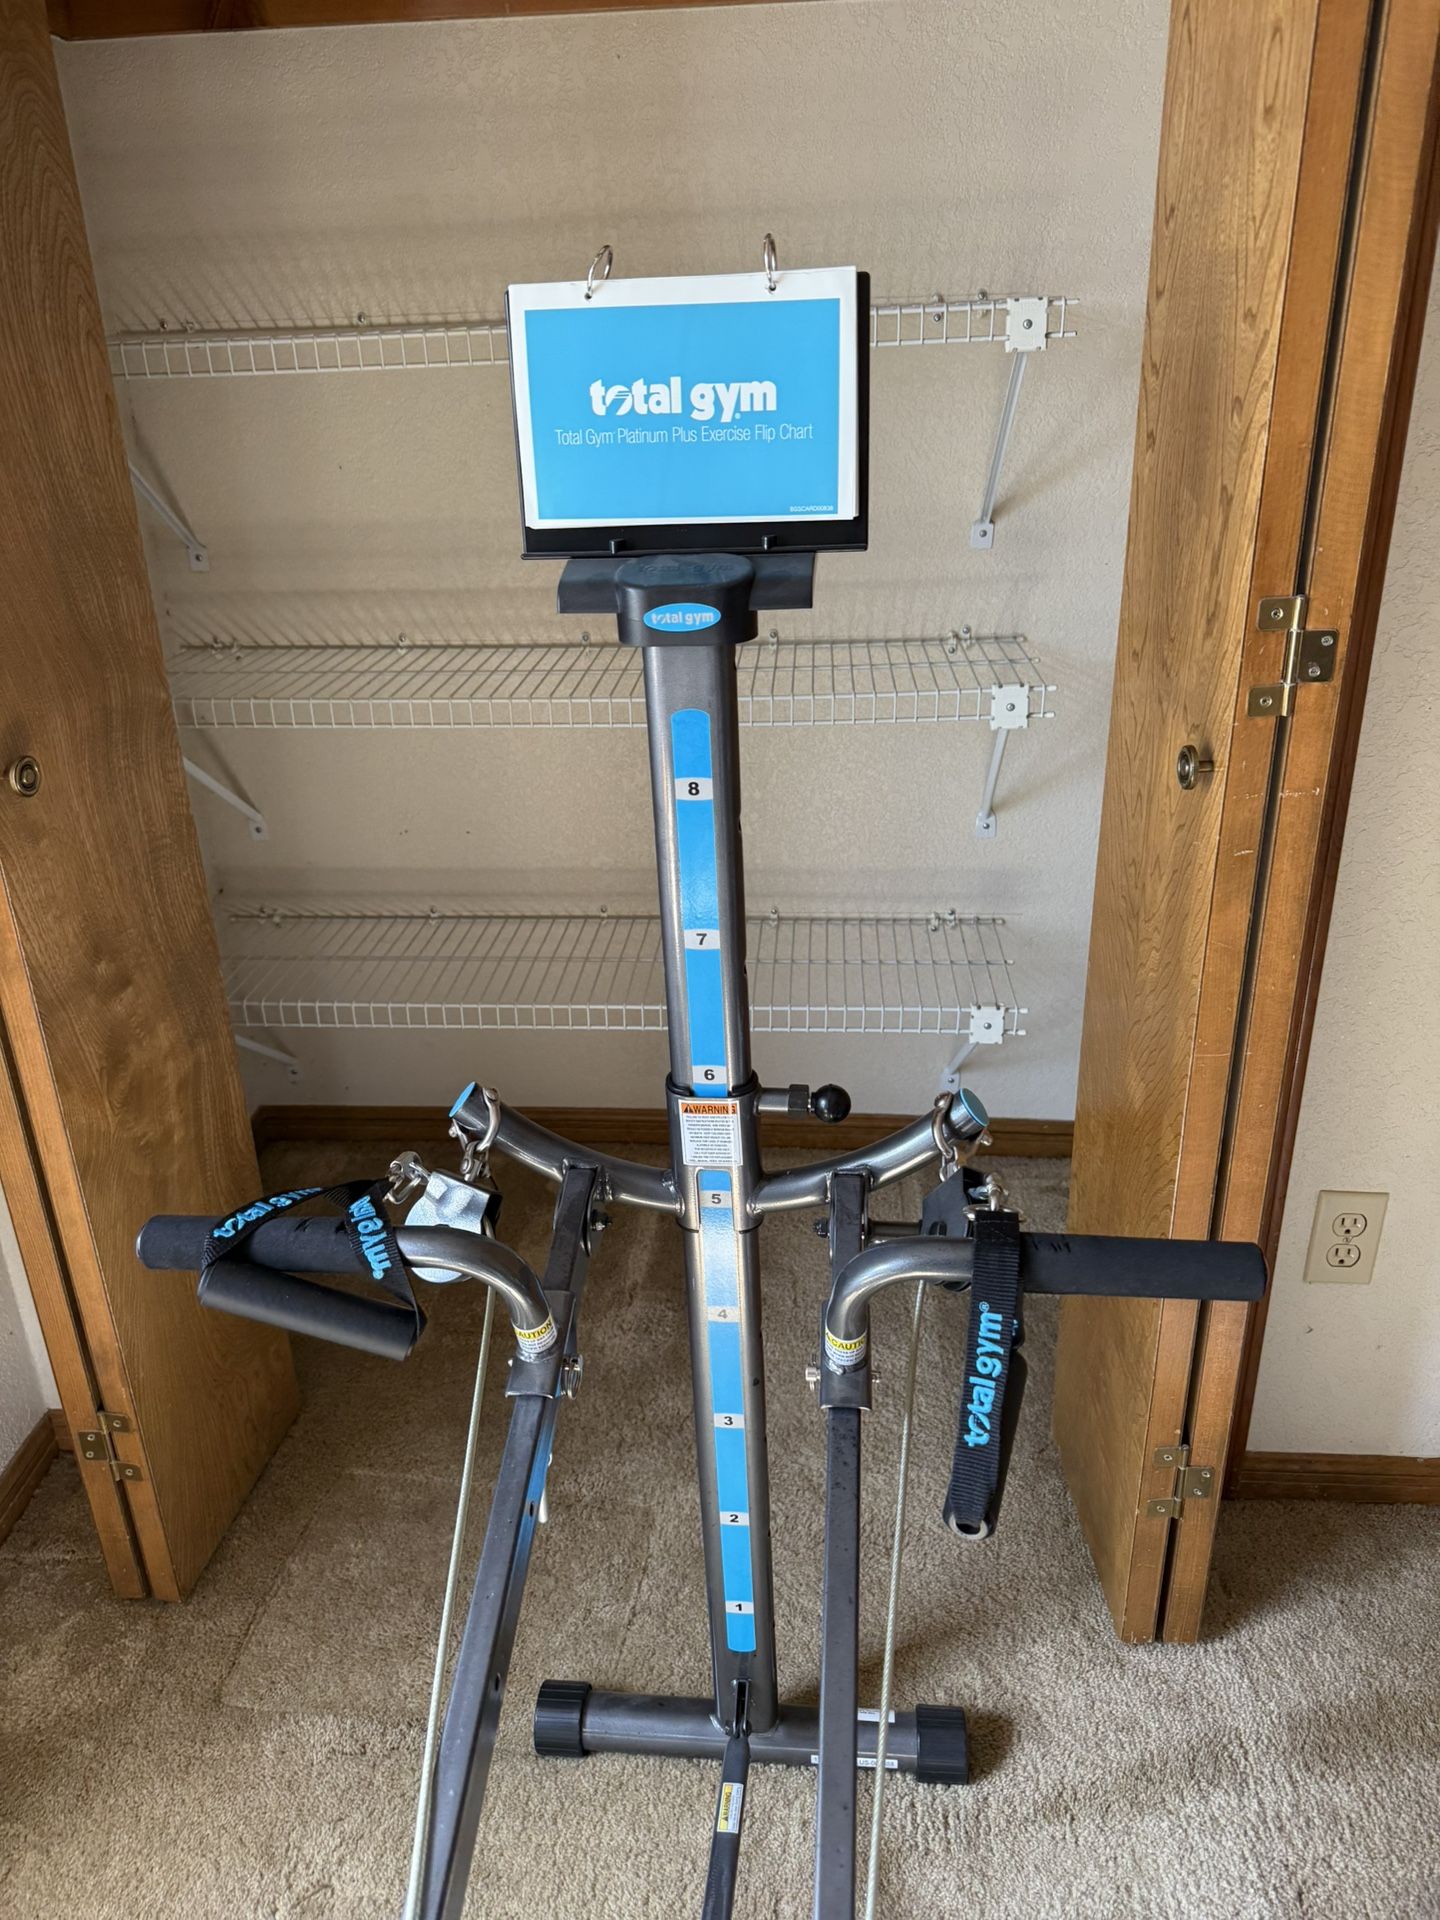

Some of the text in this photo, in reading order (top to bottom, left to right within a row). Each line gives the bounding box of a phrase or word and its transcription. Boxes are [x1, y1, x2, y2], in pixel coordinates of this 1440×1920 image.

[589, 376, 777, 423] total gym
[554, 429, 582, 446] Total
[617, 427, 668, 444] Platinum
[672, 426, 698, 442] Plus
[701, 425, 751, 442] Exercise
[755, 424, 776, 443] Flip
[780, 423, 814, 440] Chart
[651, 611, 714, 625] total gym
[688, 781, 699, 796] 8
[696, 933, 707, 946] 7
[704, 1069, 715, 1081] 6
[711, 1193, 722, 1205] 5
[718, 1309, 728, 1319] 4
[964, 1376, 996, 1447] total
[724, 1416, 733, 1426] 3
[730, 1514, 739, 1523] 2
[735, 1603, 742, 1612] 1
